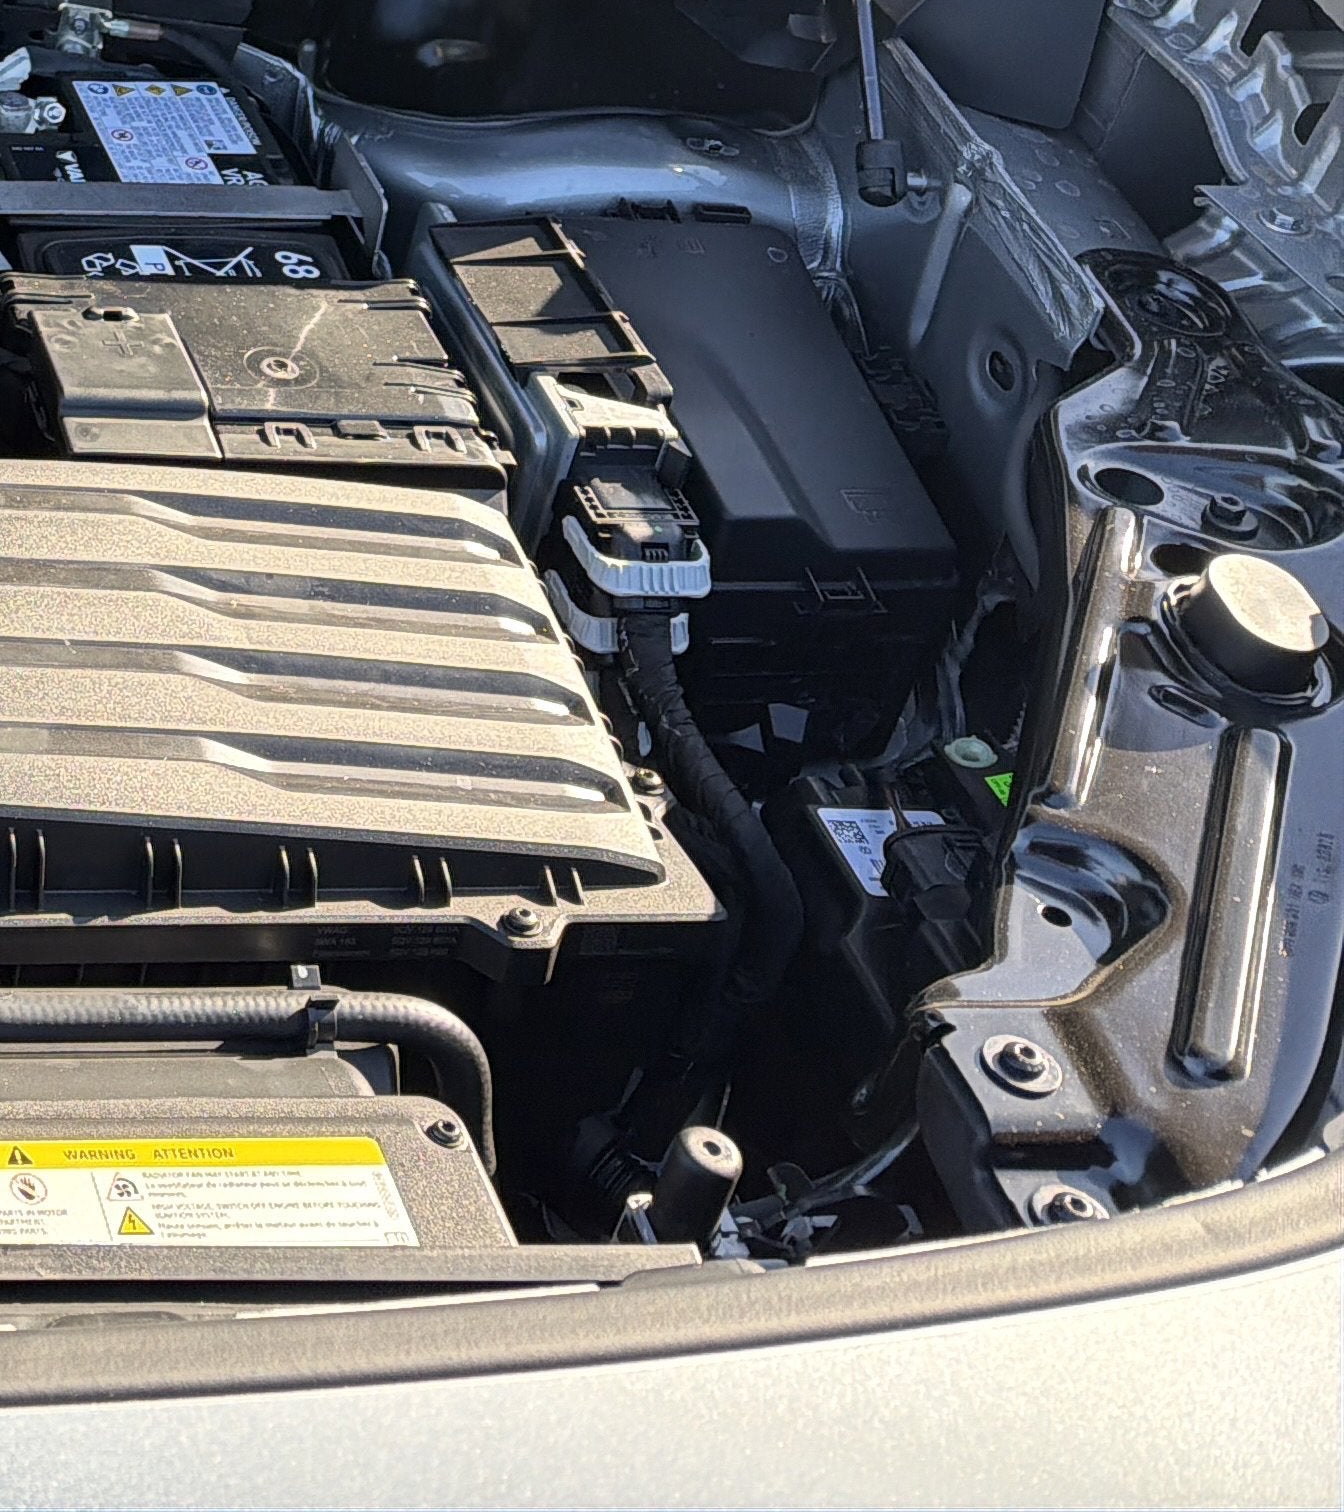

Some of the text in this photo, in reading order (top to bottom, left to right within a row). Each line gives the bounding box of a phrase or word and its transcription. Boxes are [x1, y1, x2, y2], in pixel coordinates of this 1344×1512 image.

[274, 250, 321, 279] 68
[62, 1147, 235, 1162] WARNING ATTENTION
